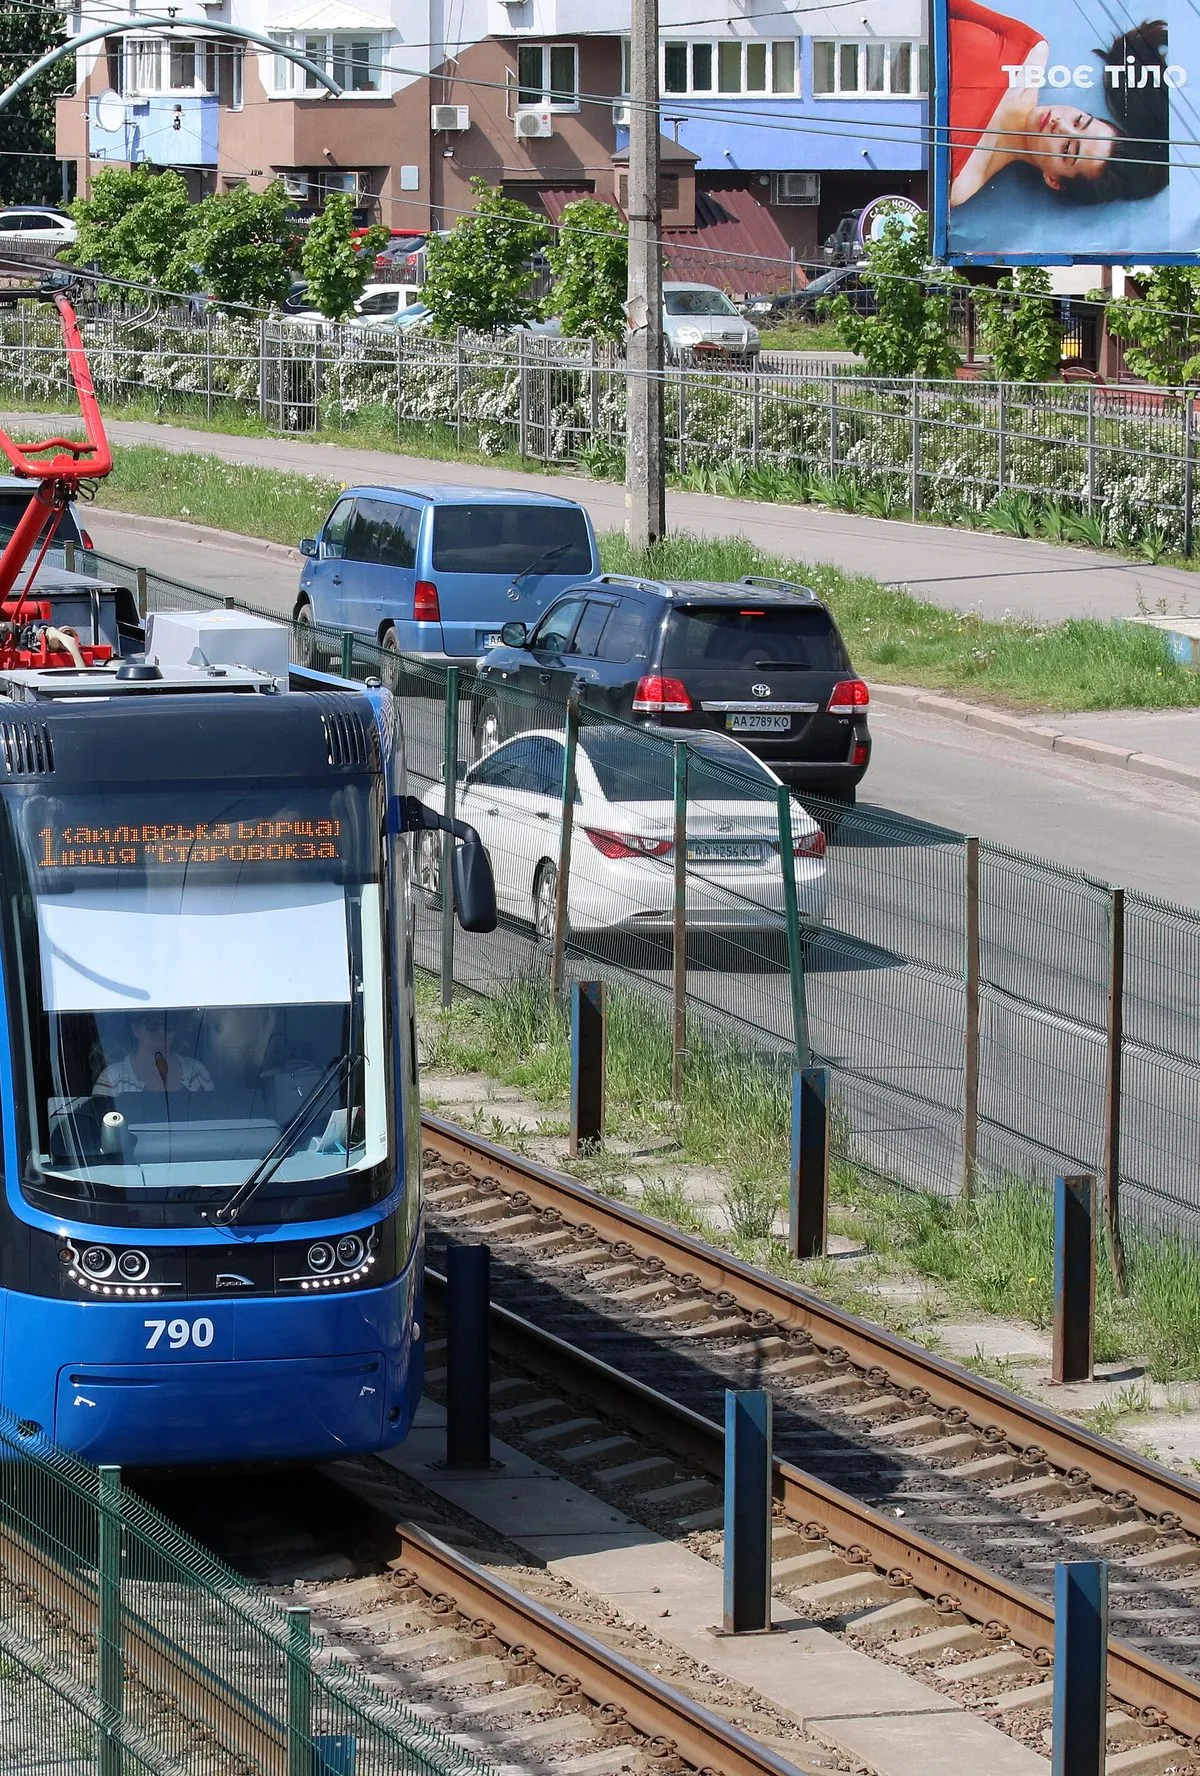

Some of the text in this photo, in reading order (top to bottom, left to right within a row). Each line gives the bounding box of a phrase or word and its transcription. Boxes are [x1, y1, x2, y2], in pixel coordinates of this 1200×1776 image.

[1001, 55, 1187, 89] твоє тіло
[892, 199, 920, 217] HOUSE
[733, 716, 789, 728] AA 2789 KO
[38, 828, 58, 867] 1
[144, 1317, 214, 1349] 790
